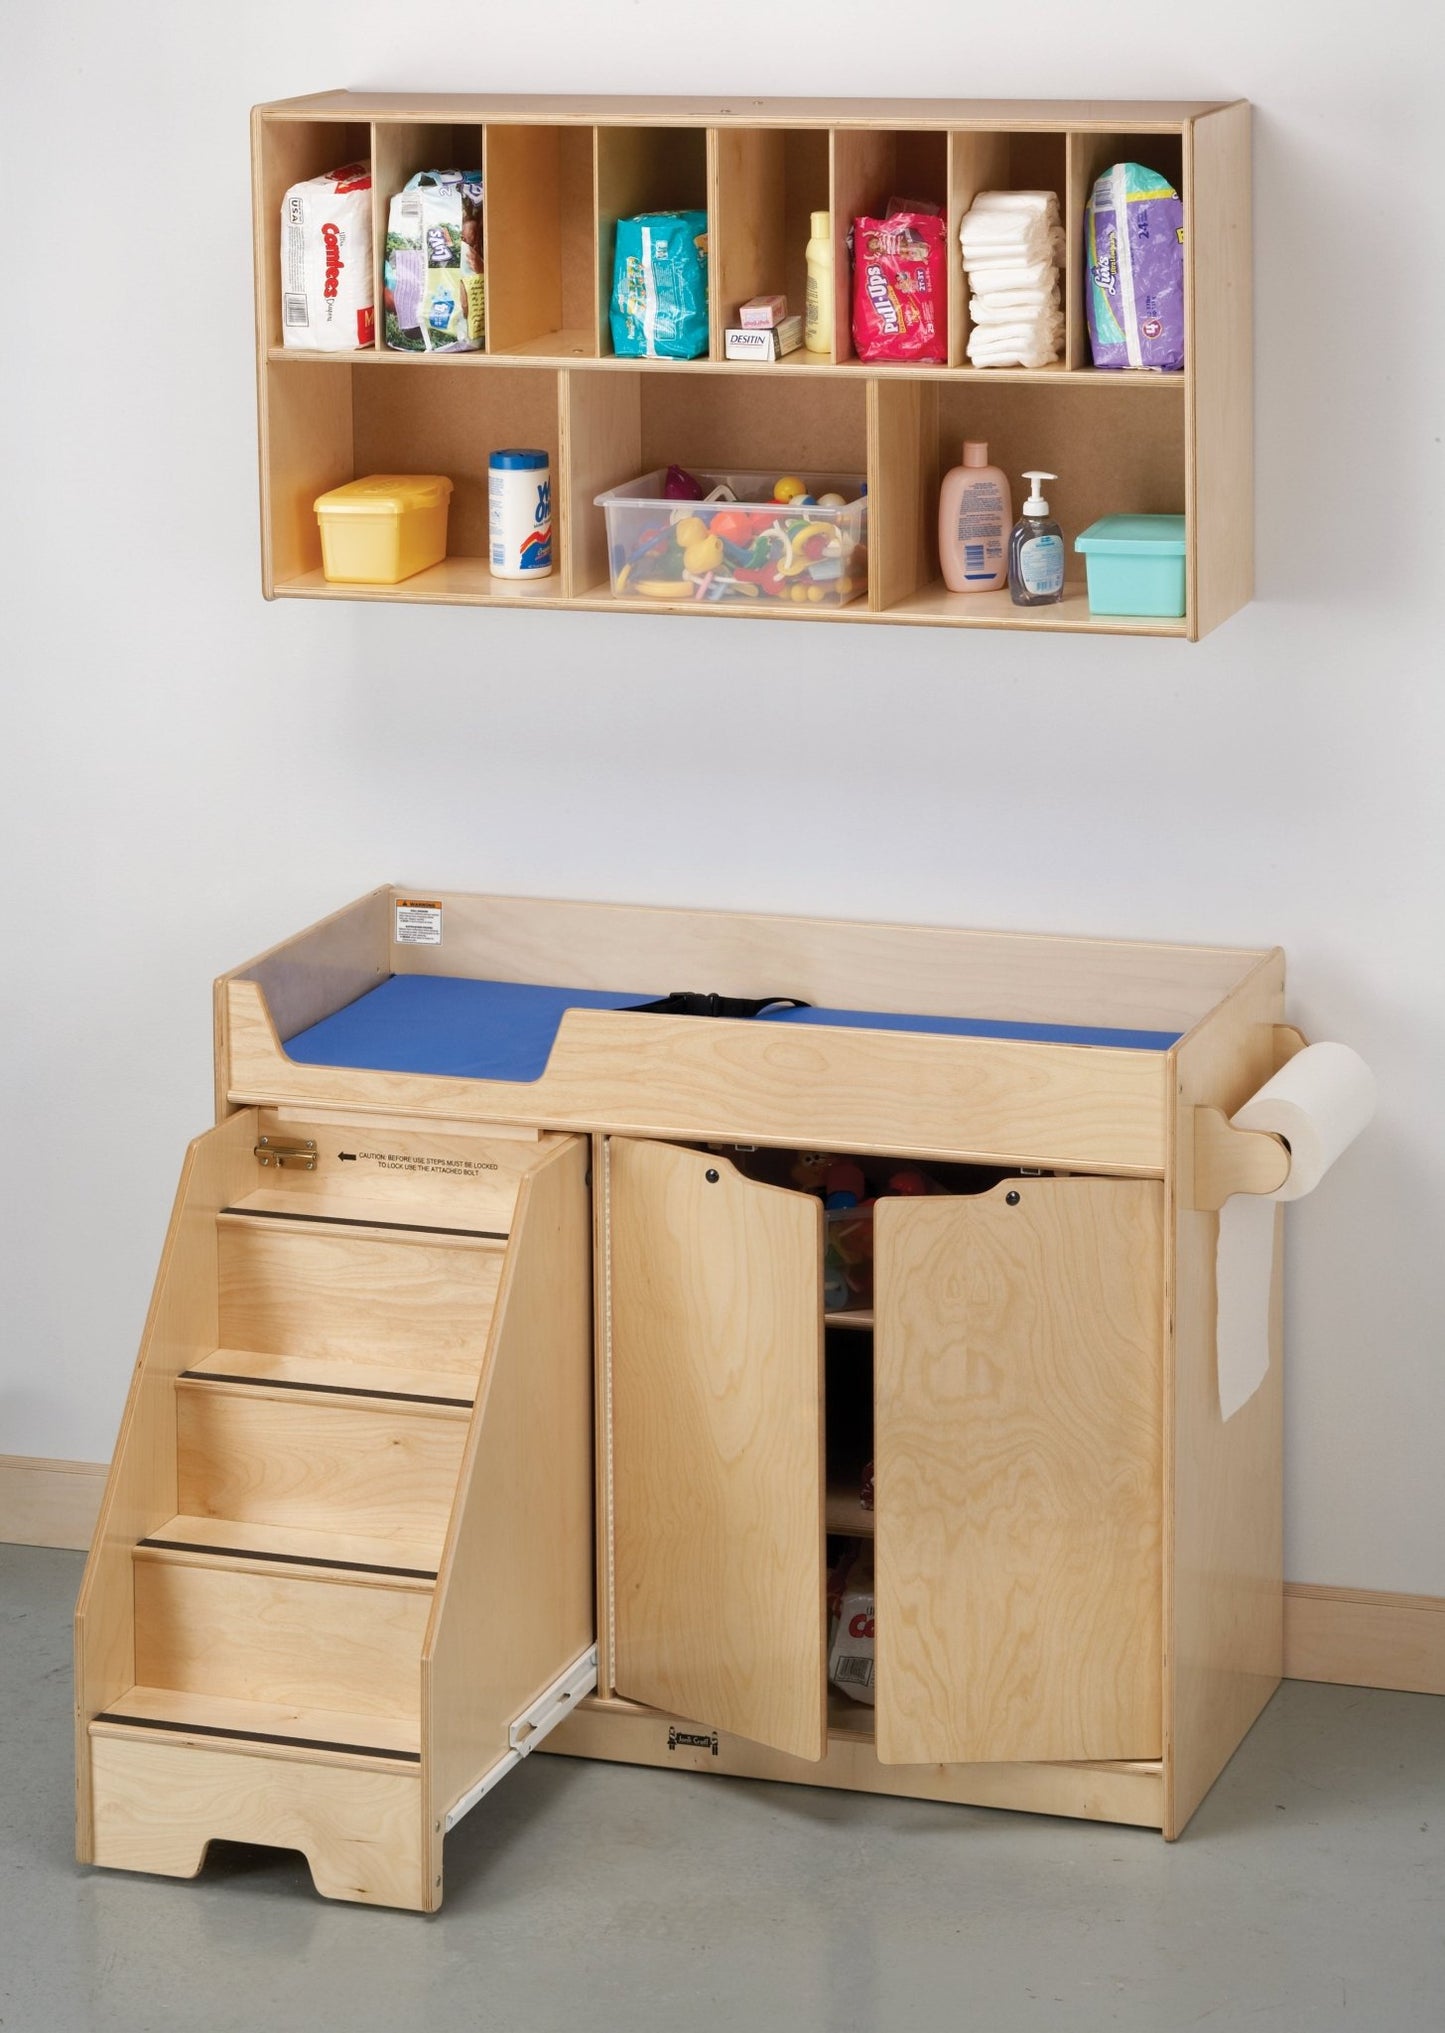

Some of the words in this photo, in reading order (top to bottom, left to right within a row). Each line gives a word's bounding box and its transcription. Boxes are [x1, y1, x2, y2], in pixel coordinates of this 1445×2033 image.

[291, 200, 300, 222] USA
[730, 334, 766, 345] DESITIN
[387, 1154, 411, 1163] BEFORE
[426, 1158, 446, 1166] STEPS
[446, 1160, 463, 1168] MUST
[473, 1162, 498, 1171] LOCKED
[387, 1162, 404, 1170] LOCK
[431, 1166, 463, 1175] ATTACHED
[463, 1168, 479, 1176] BOLT
